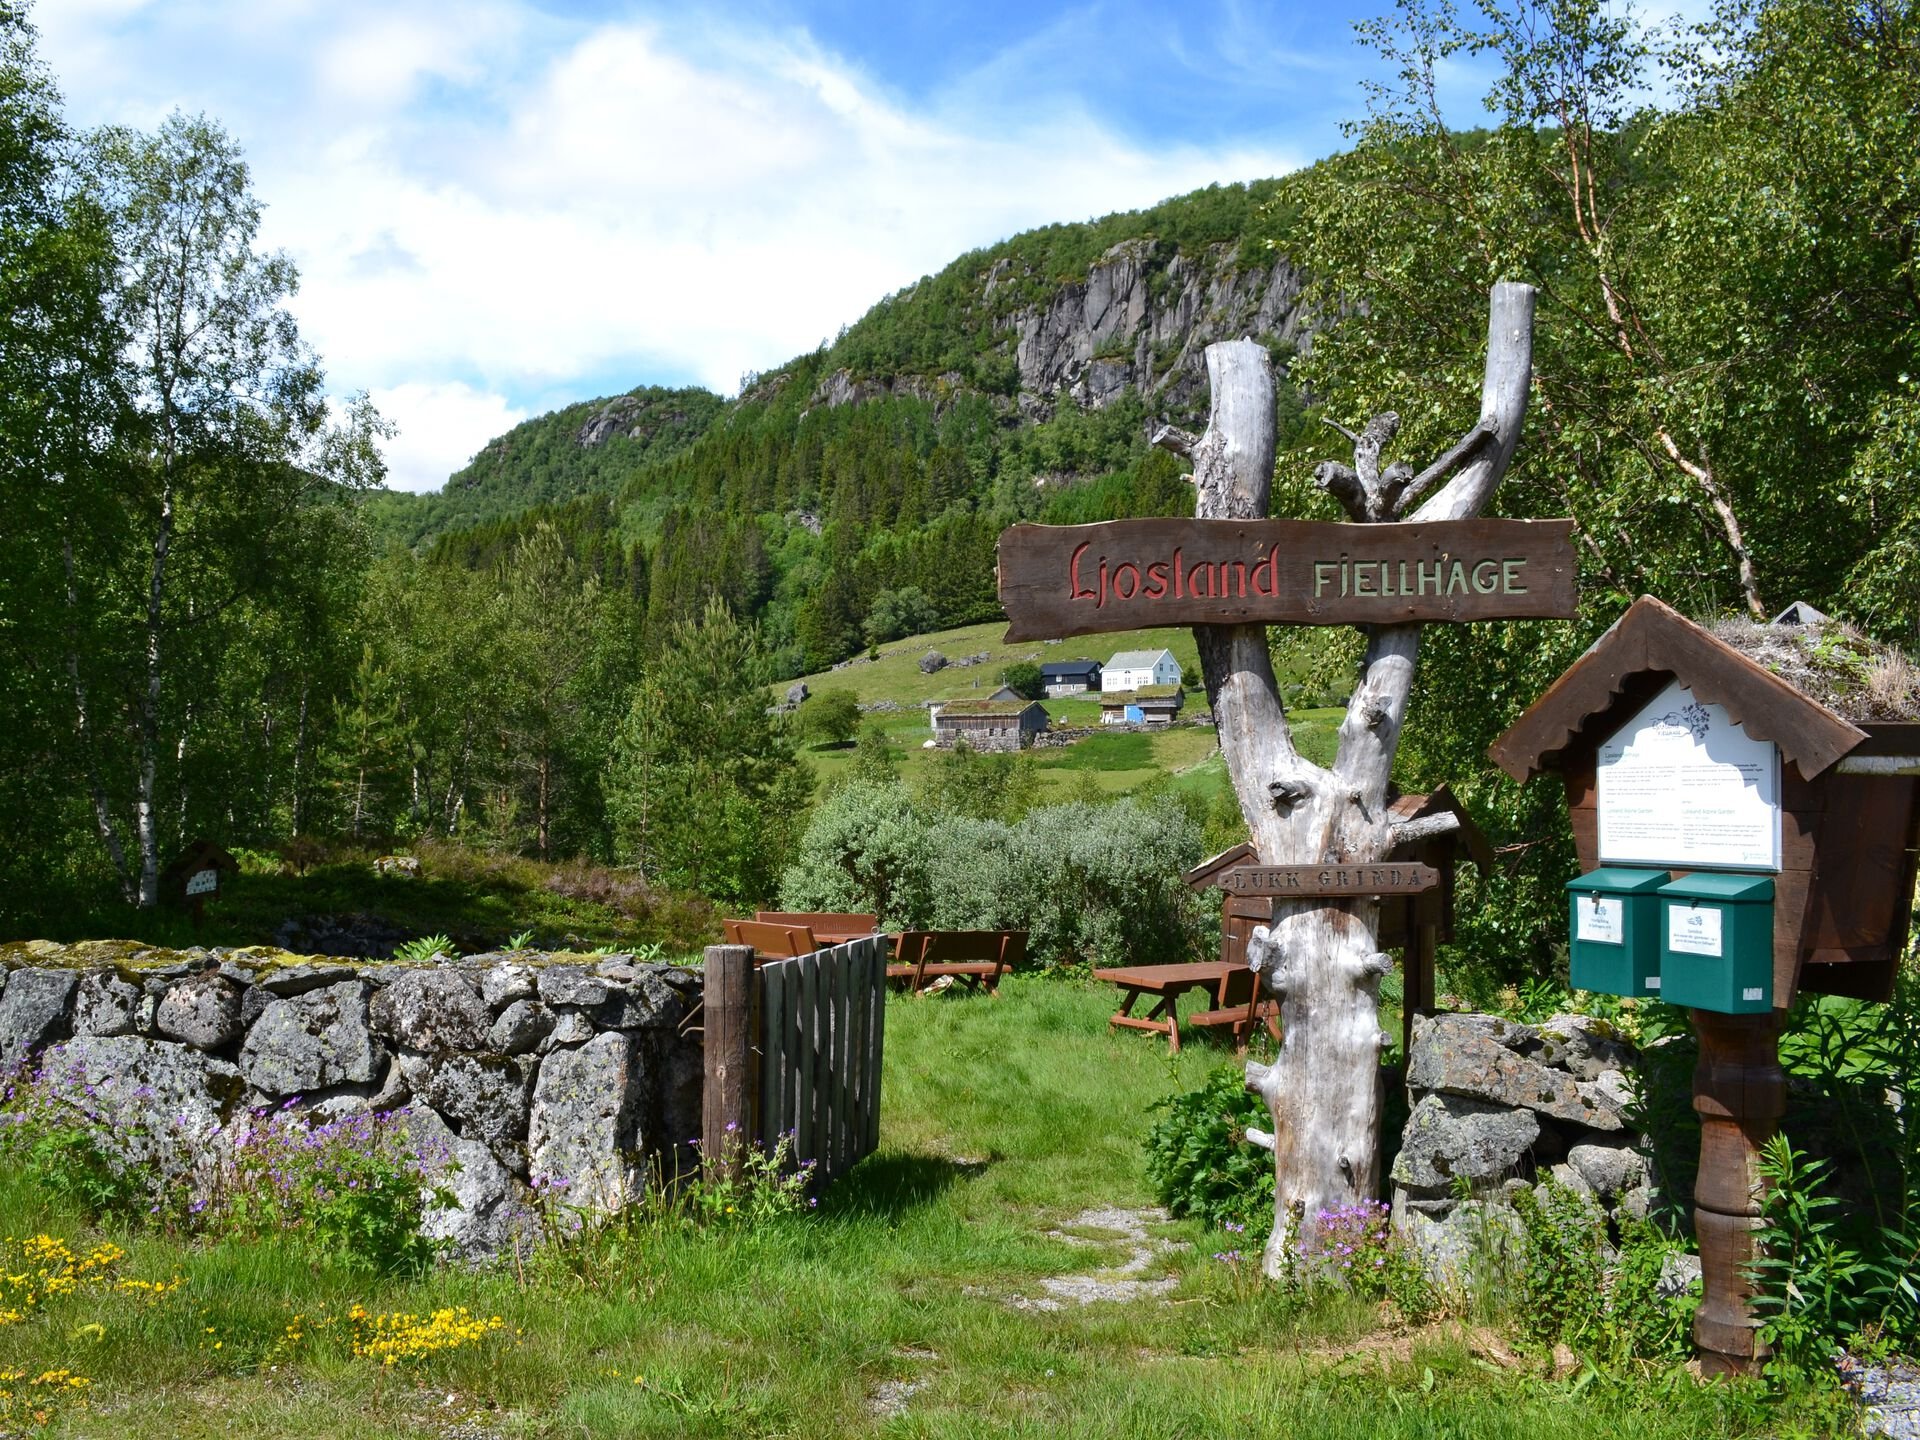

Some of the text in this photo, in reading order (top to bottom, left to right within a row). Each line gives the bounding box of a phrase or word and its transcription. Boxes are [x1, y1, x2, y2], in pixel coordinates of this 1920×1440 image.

[1069, 541, 1280, 609] Ljosland
[1233, 868, 1423, 889] LUKK GRINDA
